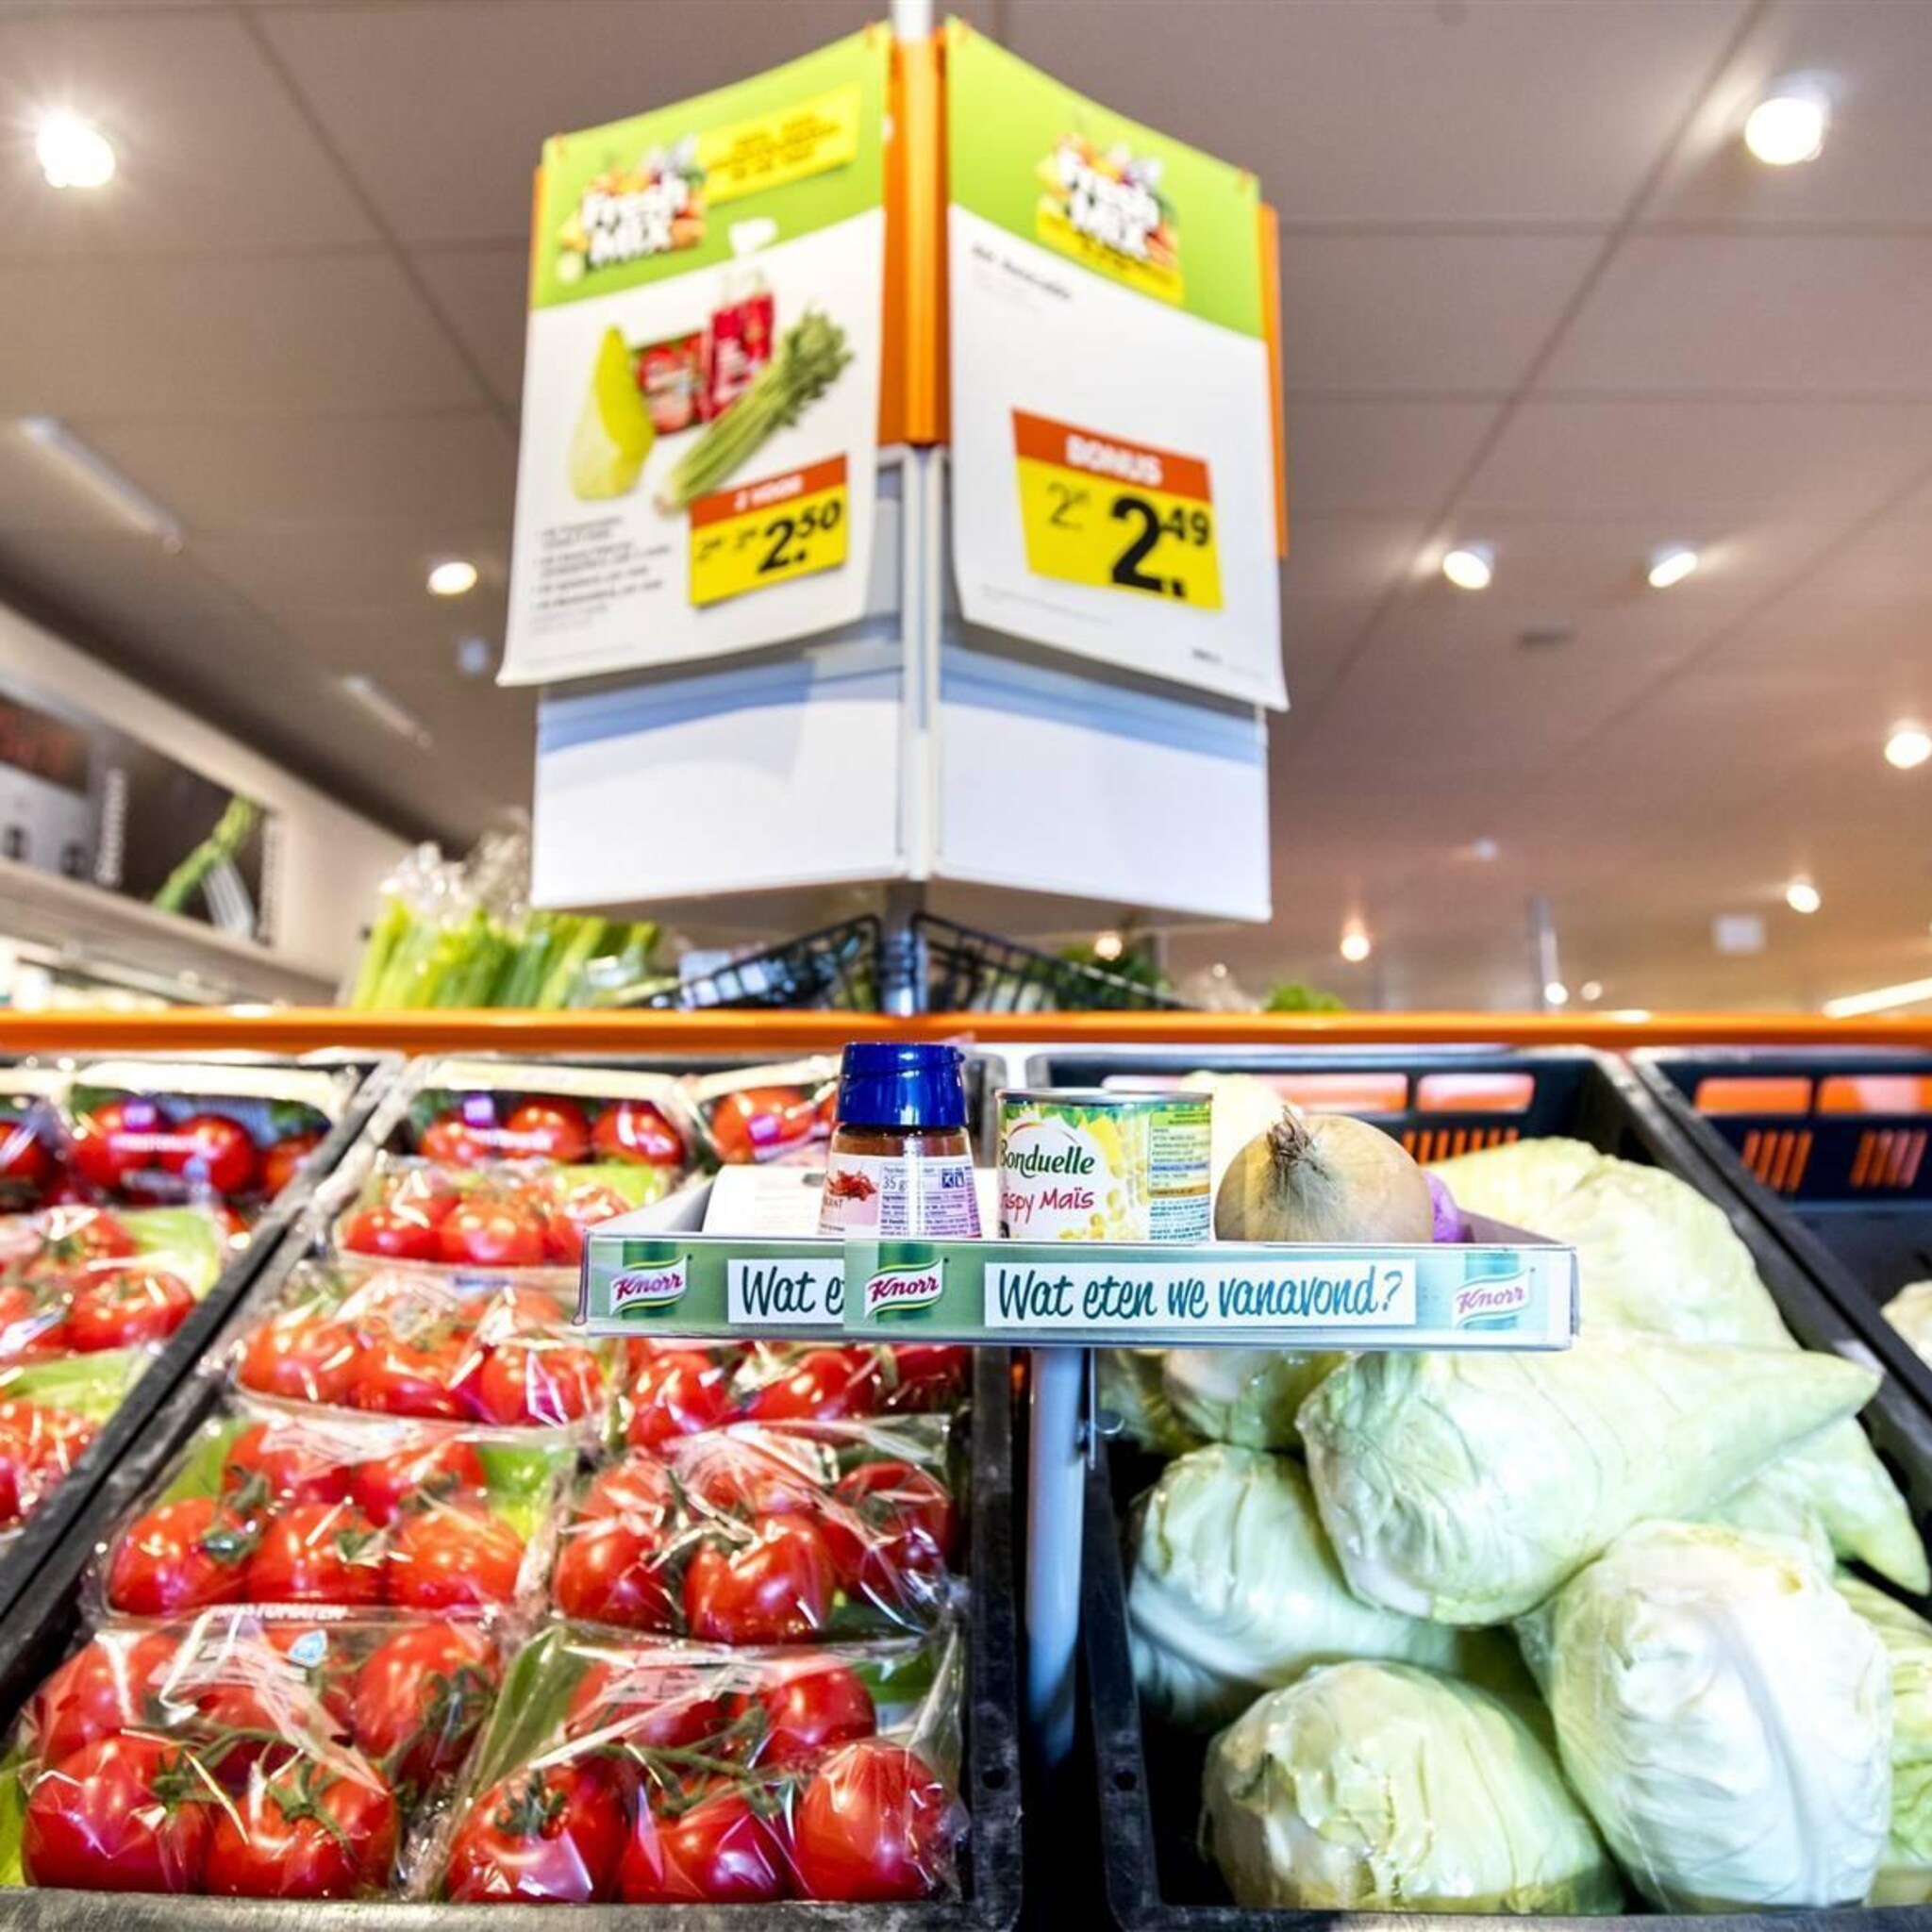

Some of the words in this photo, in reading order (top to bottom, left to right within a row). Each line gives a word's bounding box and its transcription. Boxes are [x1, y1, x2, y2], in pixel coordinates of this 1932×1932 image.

[1065, 434, 1164, 487] BONUS
[1001, 1139, 1095, 1179] Bonduelle
[1039, 1187, 1095, 1210] Maïs
[614, 1273, 684, 1301] Knorr
[741, 1265, 817, 1317] Wat
[867, 1275, 940, 1303] Knorr
[997, 1269, 1074, 1320] Wat
[1082, 1272, 1158, 1319] eten
[1168, 1275, 1208, 1318] we
[1217, 1264, 1404, 1317] vanavond?
[1456, 1286, 1525, 1314] Knorr
